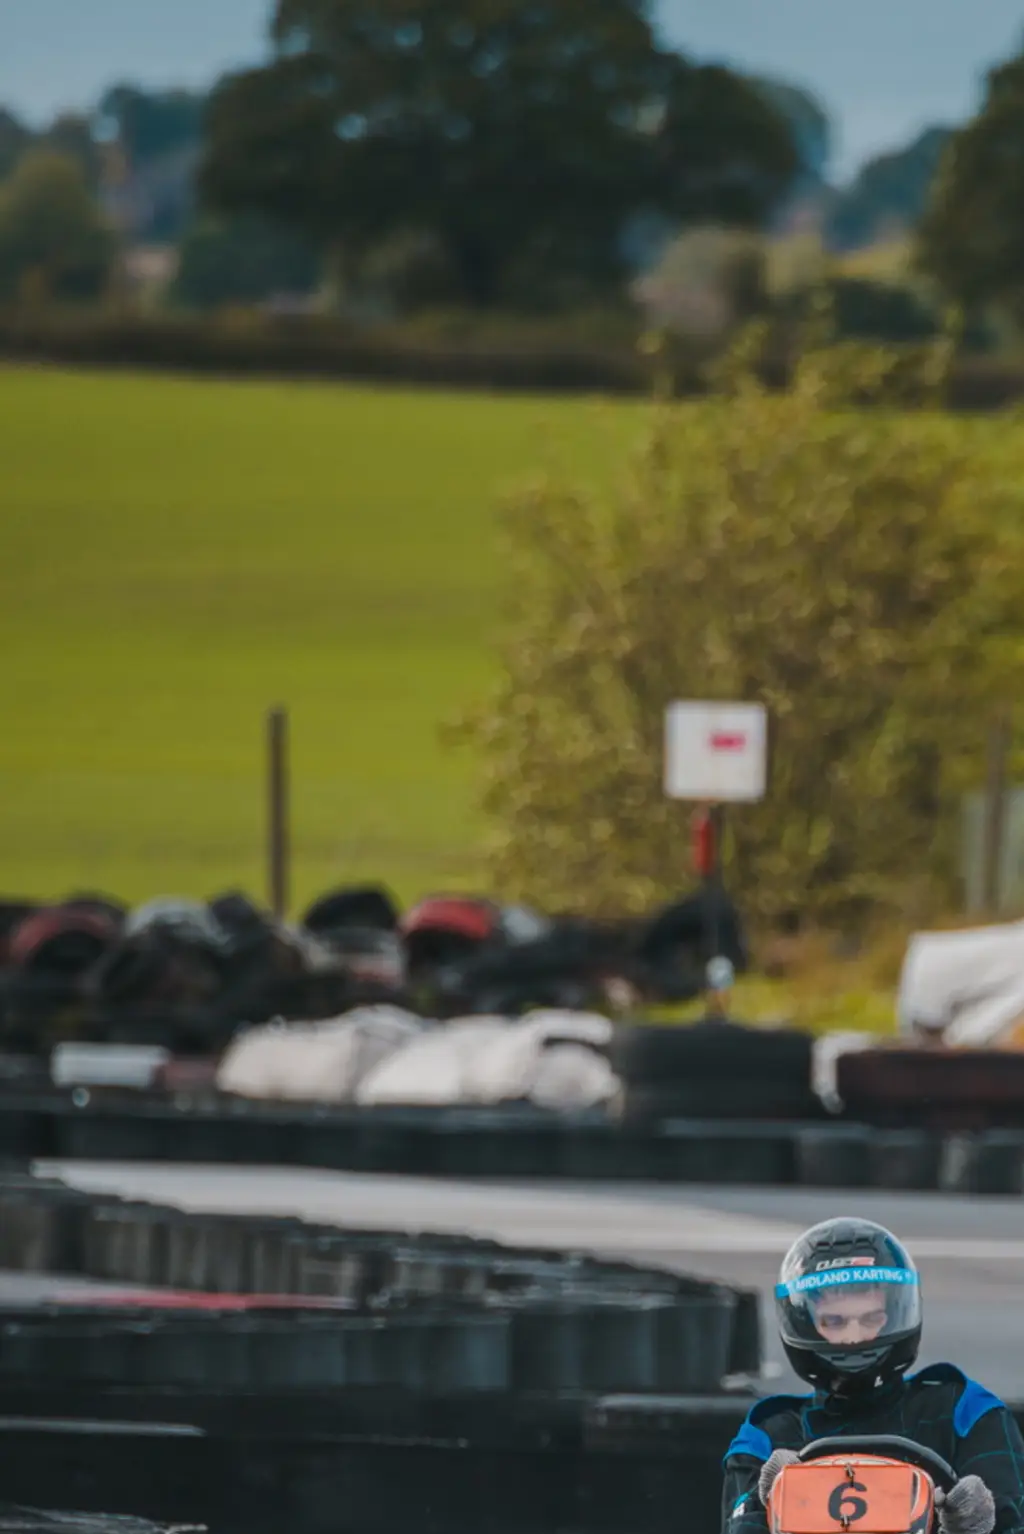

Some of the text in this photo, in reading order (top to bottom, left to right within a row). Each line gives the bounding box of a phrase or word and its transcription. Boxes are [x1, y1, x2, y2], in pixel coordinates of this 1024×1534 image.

[796, 1268, 903, 1291] MIDLAND KARTING
[828, 1482, 868, 1523] 6
